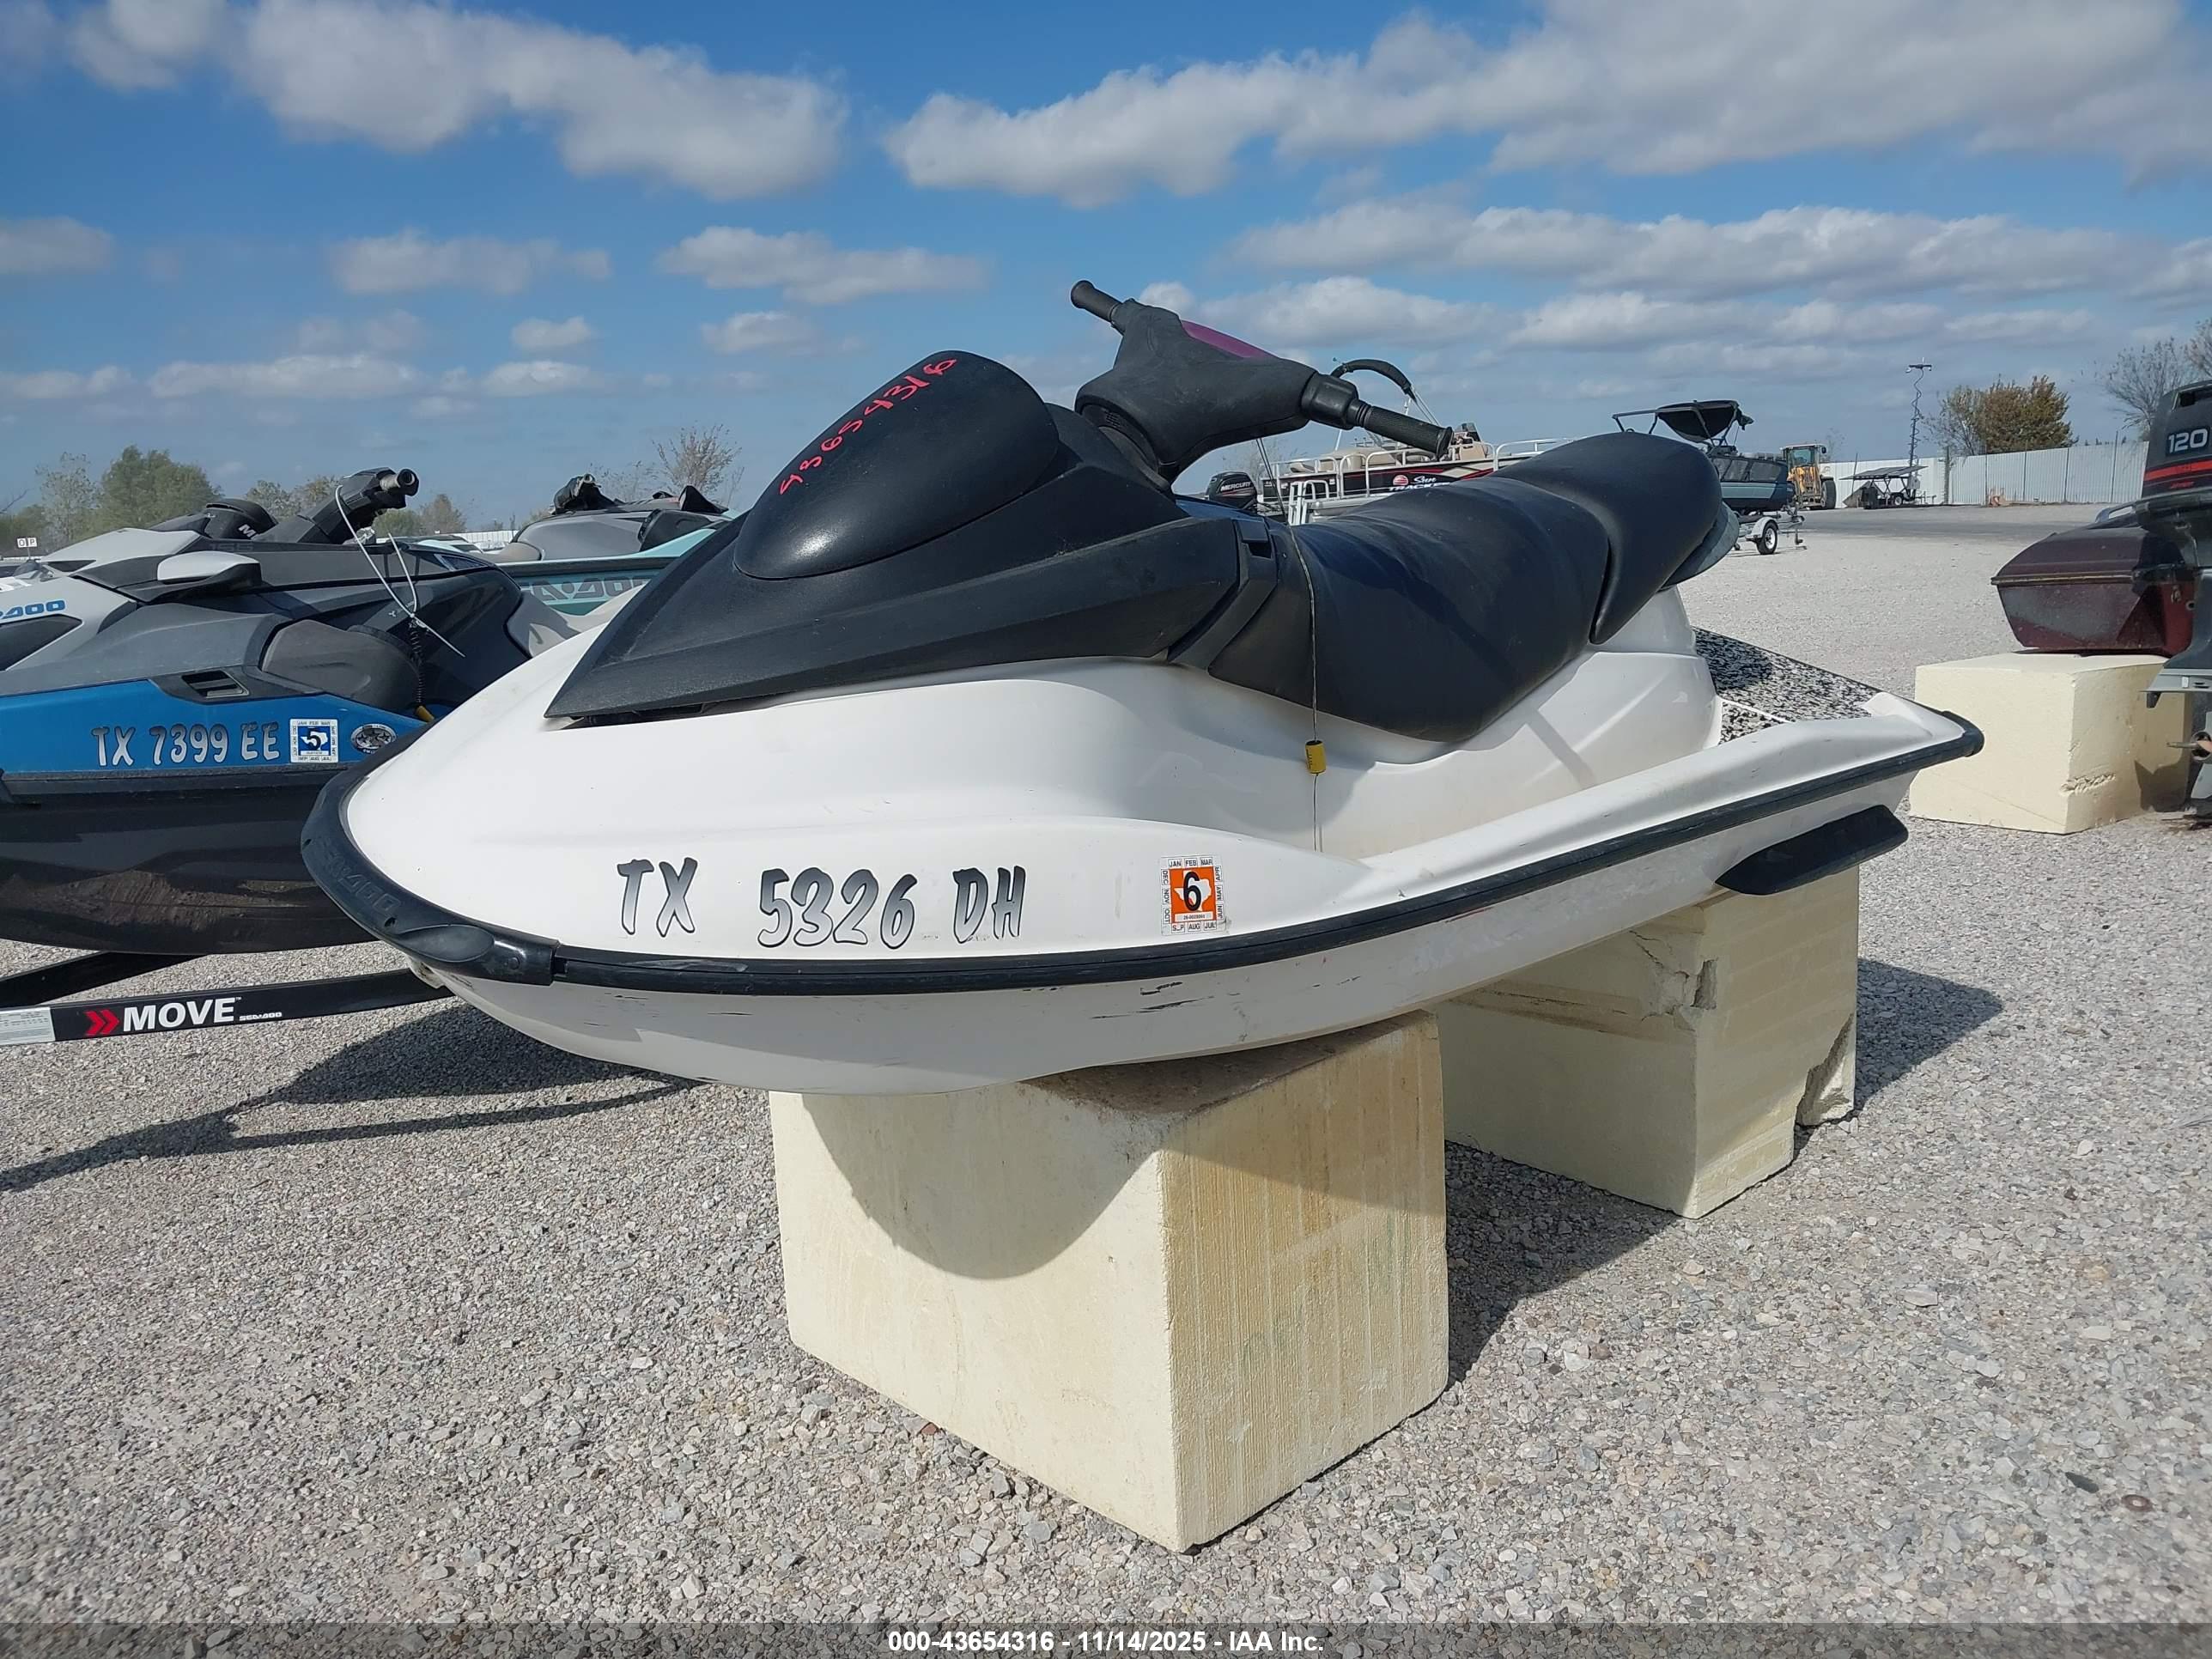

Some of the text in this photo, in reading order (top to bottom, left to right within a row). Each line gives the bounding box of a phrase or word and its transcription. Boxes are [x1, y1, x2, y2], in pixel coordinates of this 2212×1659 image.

[2168, 428, 2209, 453] 120
[91, 726, 136, 766] TX
[149, 724, 228, 765] 7399
[240, 721, 280, 761] EE
[307, 726, 322, 751] 5
[617, 856, 1027, 950] TX 5326 DH
[1183, 871, 1202, 911] 6
[123, 997, 235, 1032] MOVE
